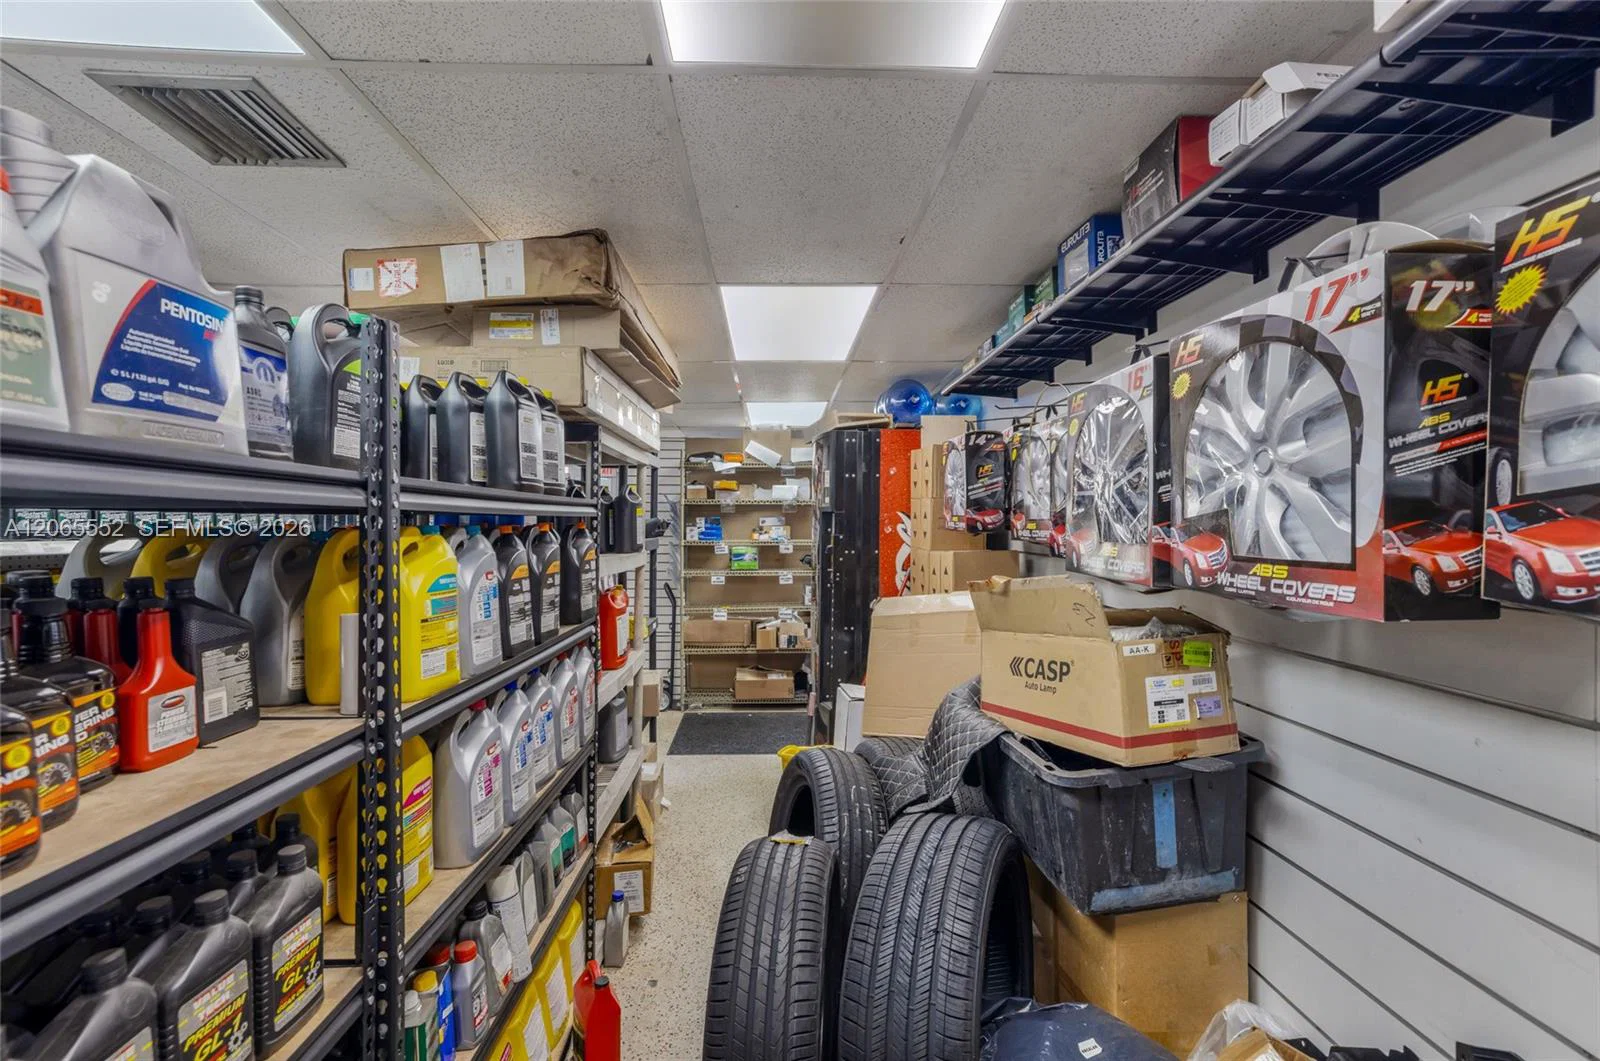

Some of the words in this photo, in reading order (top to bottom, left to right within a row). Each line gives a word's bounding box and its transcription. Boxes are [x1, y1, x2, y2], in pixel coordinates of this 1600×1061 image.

[1502, 195, 1591, 265] HS
[160, 297, 225, 334] PENTOSIN
[1347, 306, 1362, 323] 4
[1466, 312, 1478, 323] 4
[1174, 334, 1205, 368] HS
[1419, 373, 1463, 407] HS
[1418, 411, 1451, 428] ABS
[1388, 428, 1435, 448] WHEEL
[1216, 571, 1267, 592] WHEEL
[1270, 578, 1357, 604] COVERS
[1248, 563, 1289, 579] ABS
[1129, 645, 1150, 654] AA-K
[1024, 657, 1071, 683] CASP
[1025, 681, 1039, 691] Auto
[1039, 683, 1057, 695] Lamp
[275, 935, 320, 981] PREMIUM
[282, 952, 317, 989] GL-1
[184, 992, 247, 1053] PREMIUM
[194, 1012, 242, 1061] GL-1
